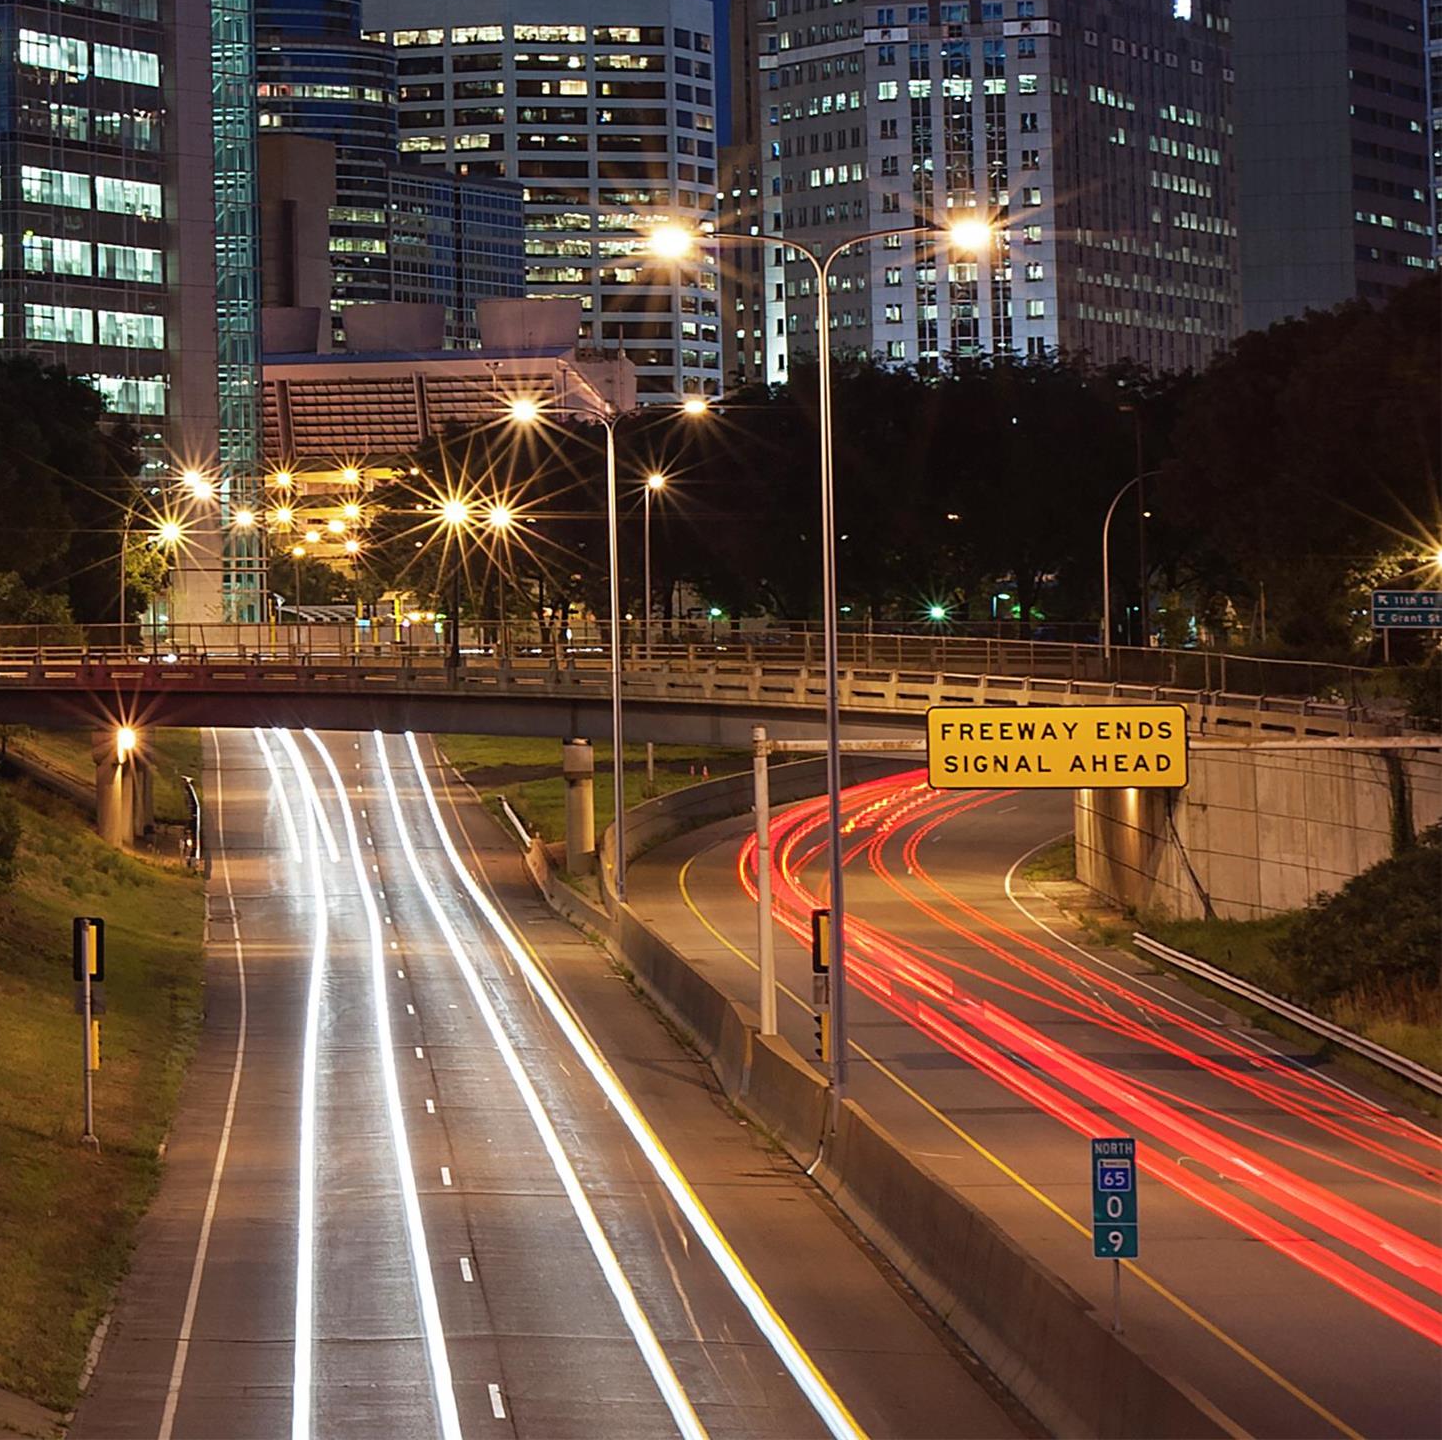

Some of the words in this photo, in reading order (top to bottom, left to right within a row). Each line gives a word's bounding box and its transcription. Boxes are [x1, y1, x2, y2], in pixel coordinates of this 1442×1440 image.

[1378, 613, 1386, 623] E
[1390, 613, 1423, 623] Grant
[1428, 613, 1441, 623] St
[941, 721, 1079, 741] FREEWAY
[1096, 721, 1173, 740] ENDS
[944, 754, 1052, 773] SIGNAL
[1069, 753, 1172, 773] AHEAD
[1094, 1142, 1133, 1155] NORTH
[1103, 1171, 1126, 1187] 65
[1106, 1195, 1124, 1218] 0
